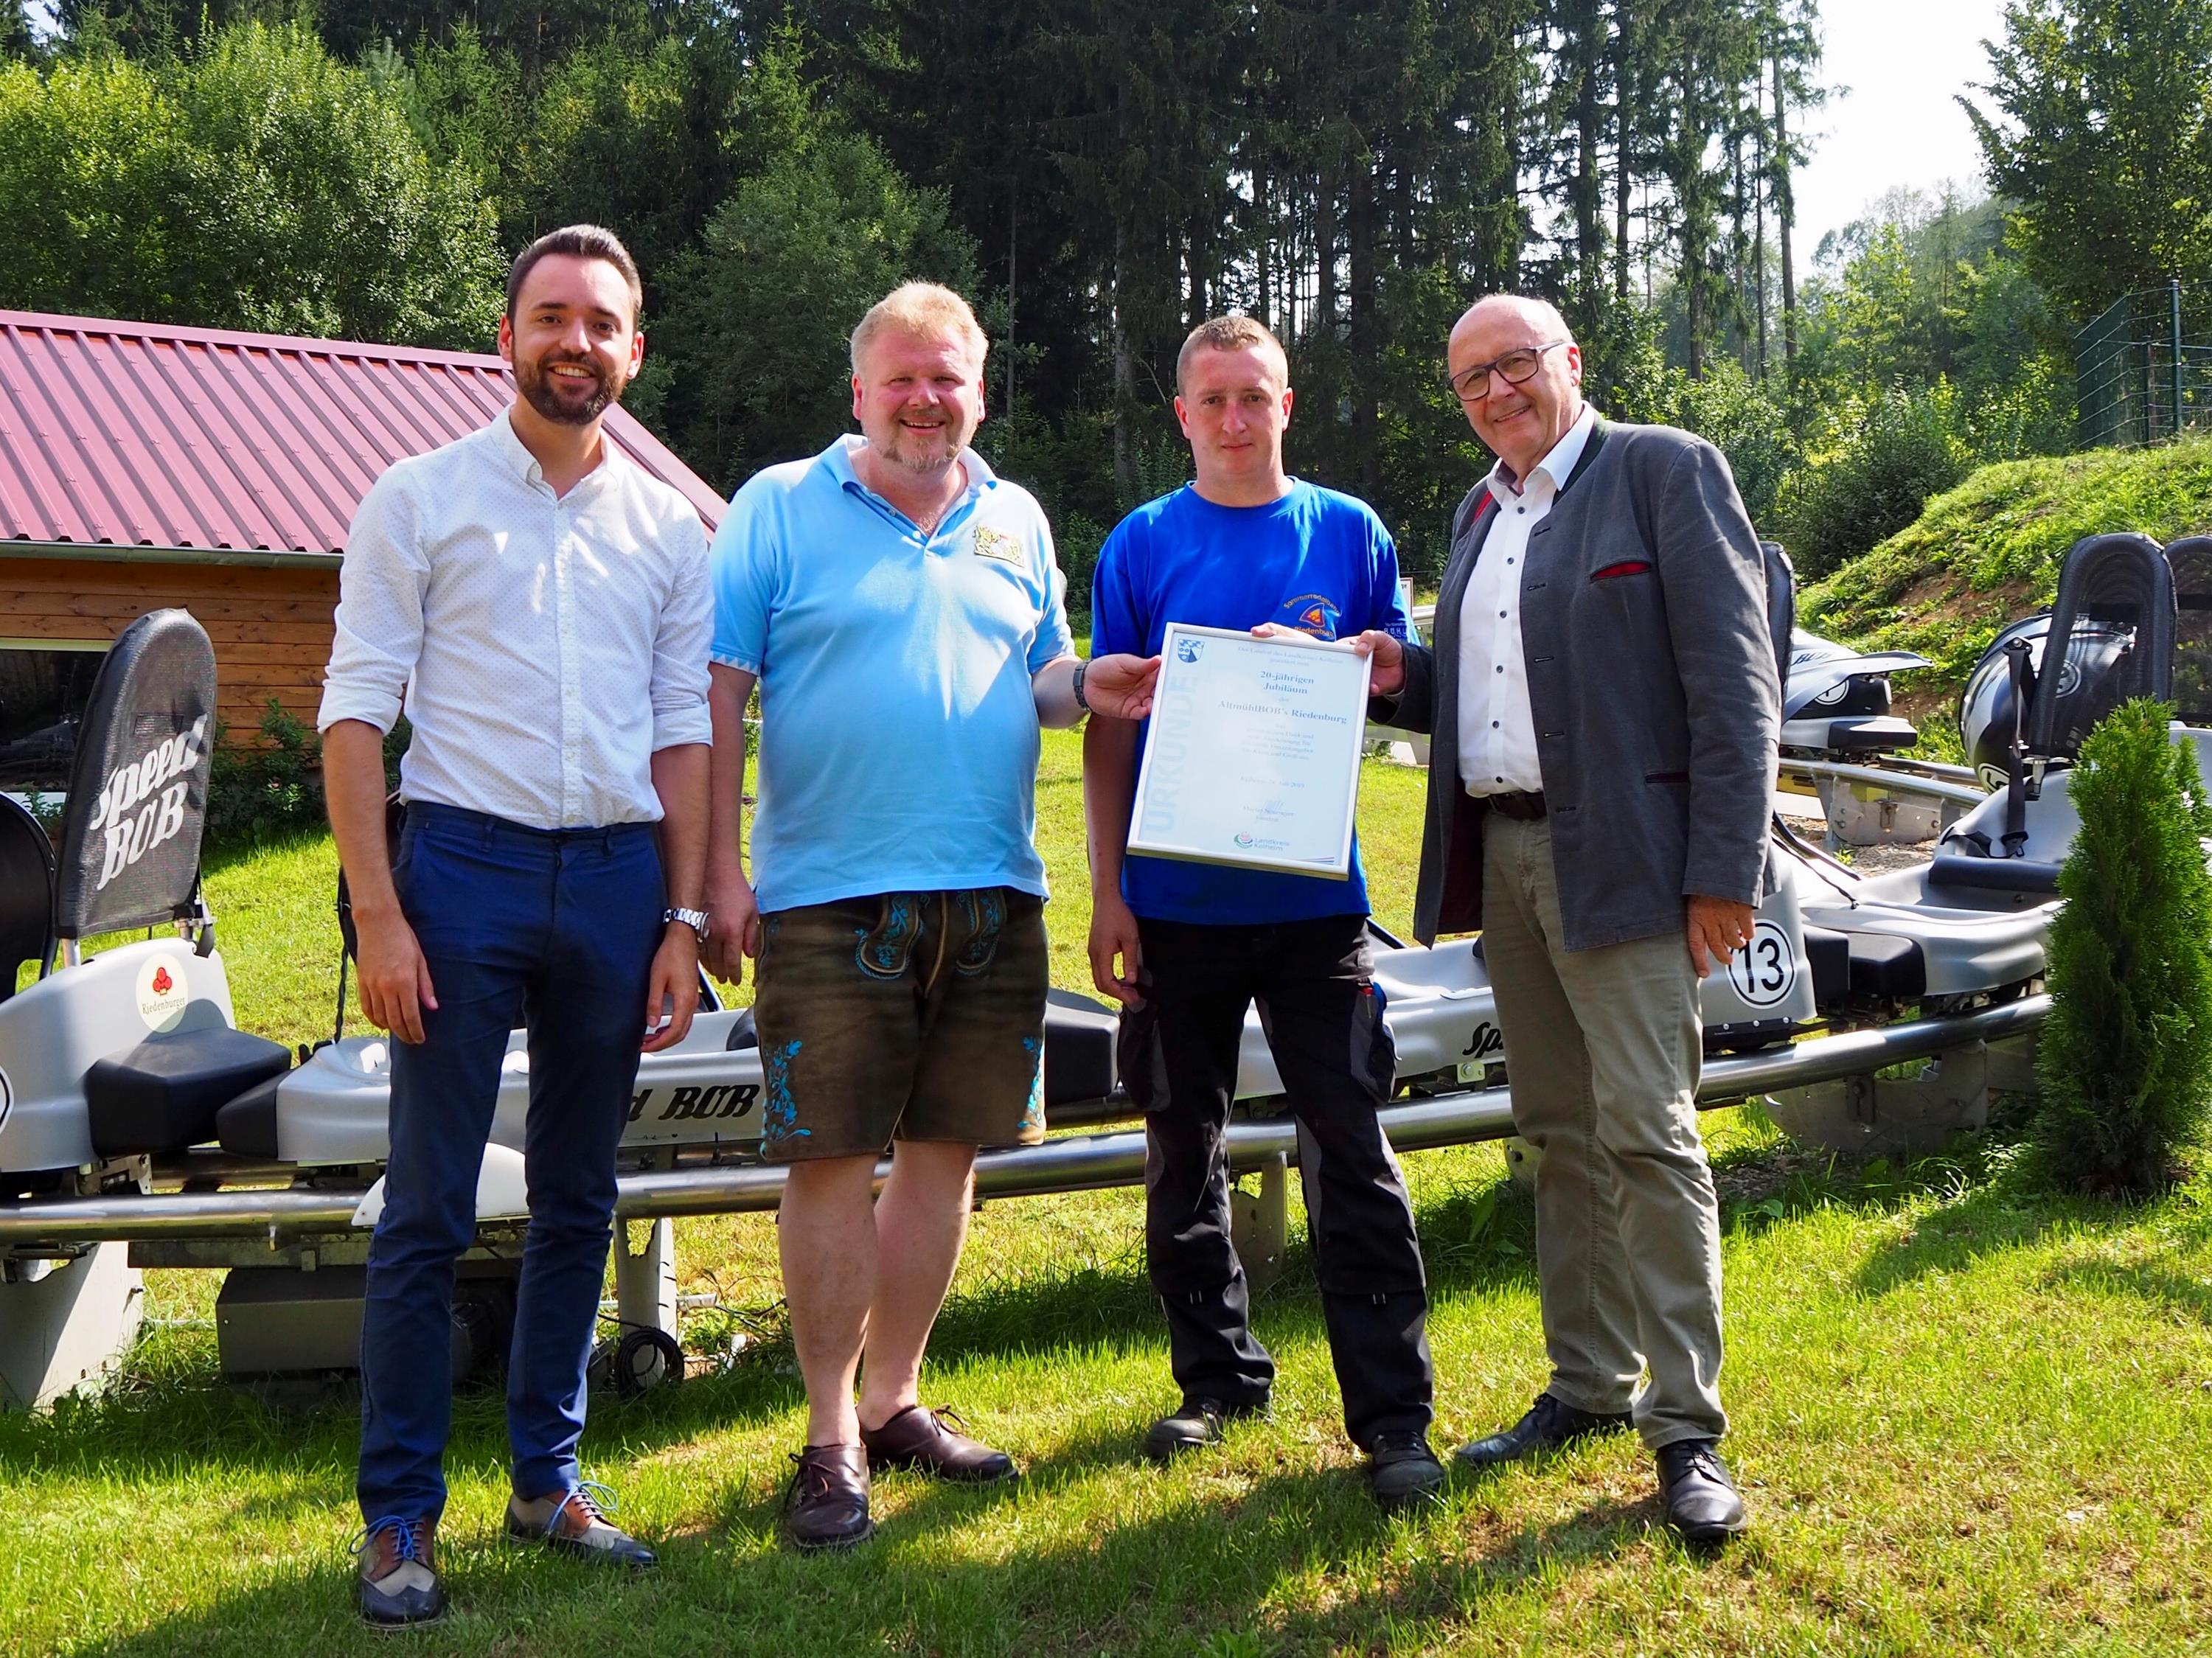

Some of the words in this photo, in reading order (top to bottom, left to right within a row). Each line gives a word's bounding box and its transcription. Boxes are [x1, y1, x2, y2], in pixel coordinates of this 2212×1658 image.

[1260, 670, 1315, 685] 20-jährigen
[1262, 683, 1308, 694] Jubiläum
[1291, 709, 1348, 724] Riedenburg
[90, 712, 208, 830] Speed
[1144, 676, 1198, 832] URKUNDE
[97, 780, 189, 891] BOB
[1738, 938, 1784, 994] 13
[142, 997, 186, 1015] Riedenburger
[1462, 1021, 1504, 1058] Sp
[658, 1084, 761, 1121] BOB
